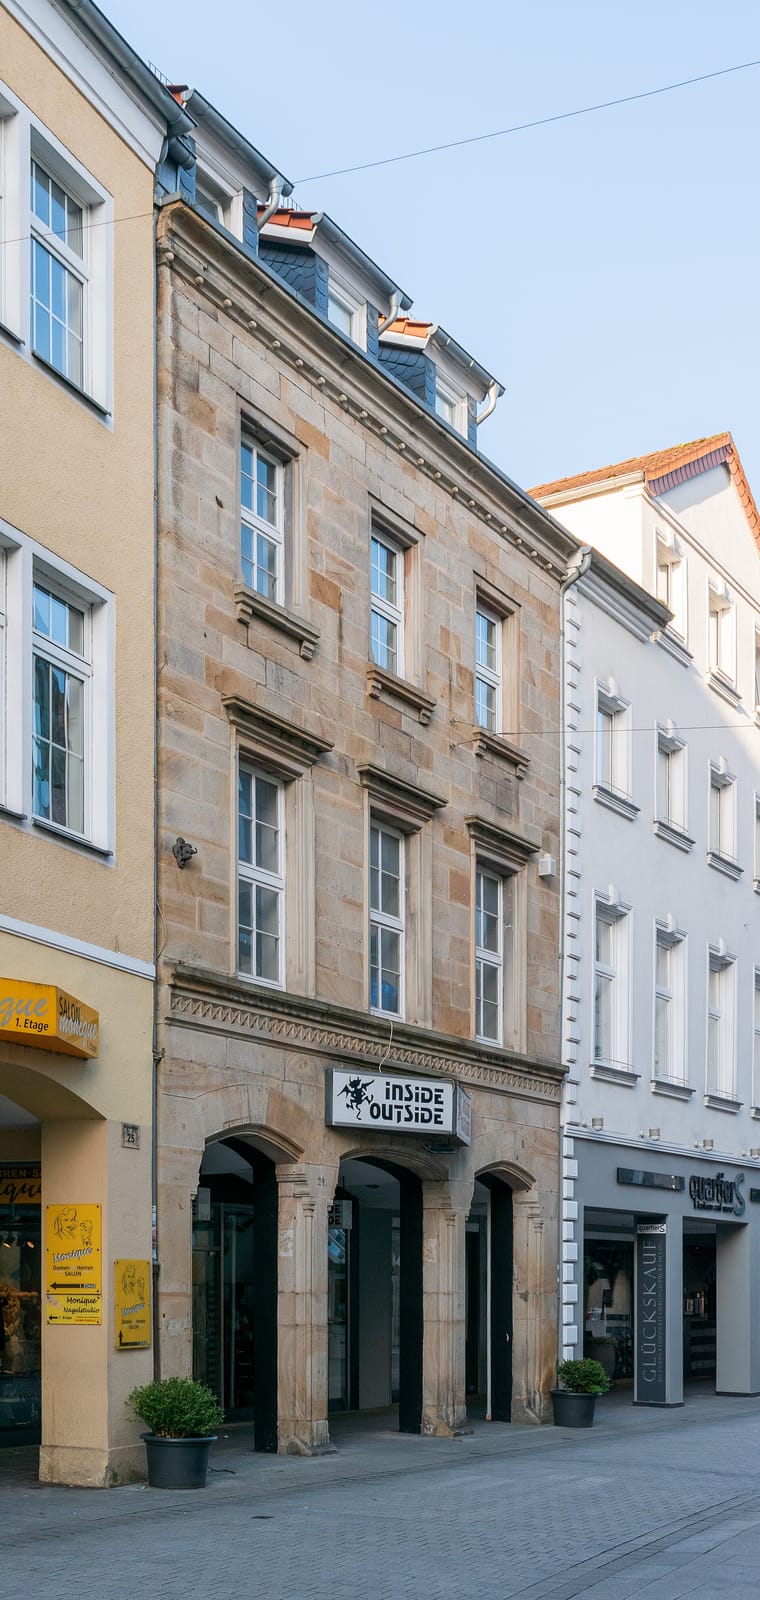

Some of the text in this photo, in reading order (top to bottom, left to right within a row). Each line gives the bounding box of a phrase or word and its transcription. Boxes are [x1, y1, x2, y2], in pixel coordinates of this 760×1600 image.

[59, 996, 81, 1025] SALON
[15, 1017, 49, 1032] 1. Etage
[127, 1133, 135, 1143] 25
[66, 1296, 97, 1307] Monique
[63, 1306, 100, 1315] Nagelstudio
[641, 1240, 657, 1383] GLÜCKSKAUF
